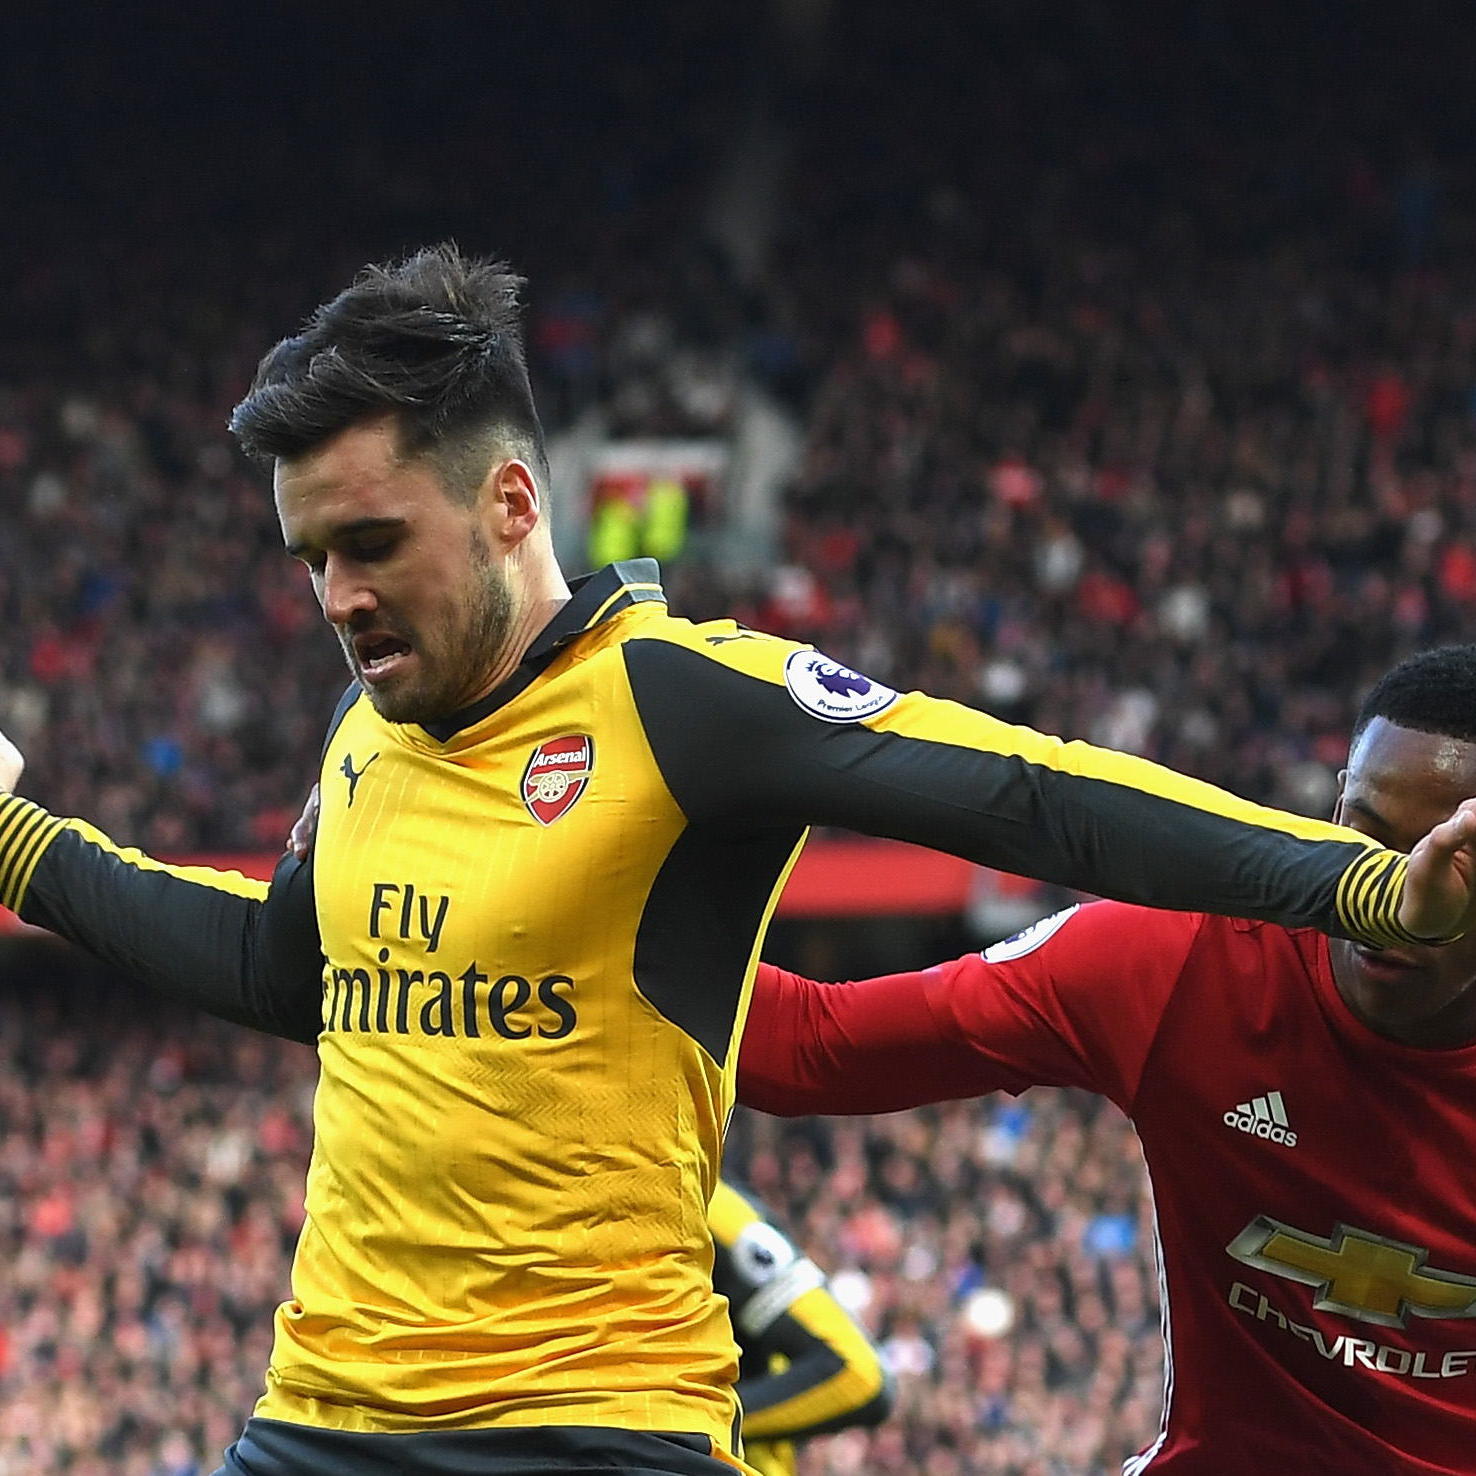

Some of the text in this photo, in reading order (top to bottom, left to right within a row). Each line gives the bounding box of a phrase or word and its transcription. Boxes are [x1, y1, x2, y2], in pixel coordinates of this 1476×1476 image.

[532, 746, 586, 768] Arsenal
[370, 883, 449, 952] Fly
[324, 947, 577, 1040] mirates
[1223, 1111, 1298, 1148] adidas
